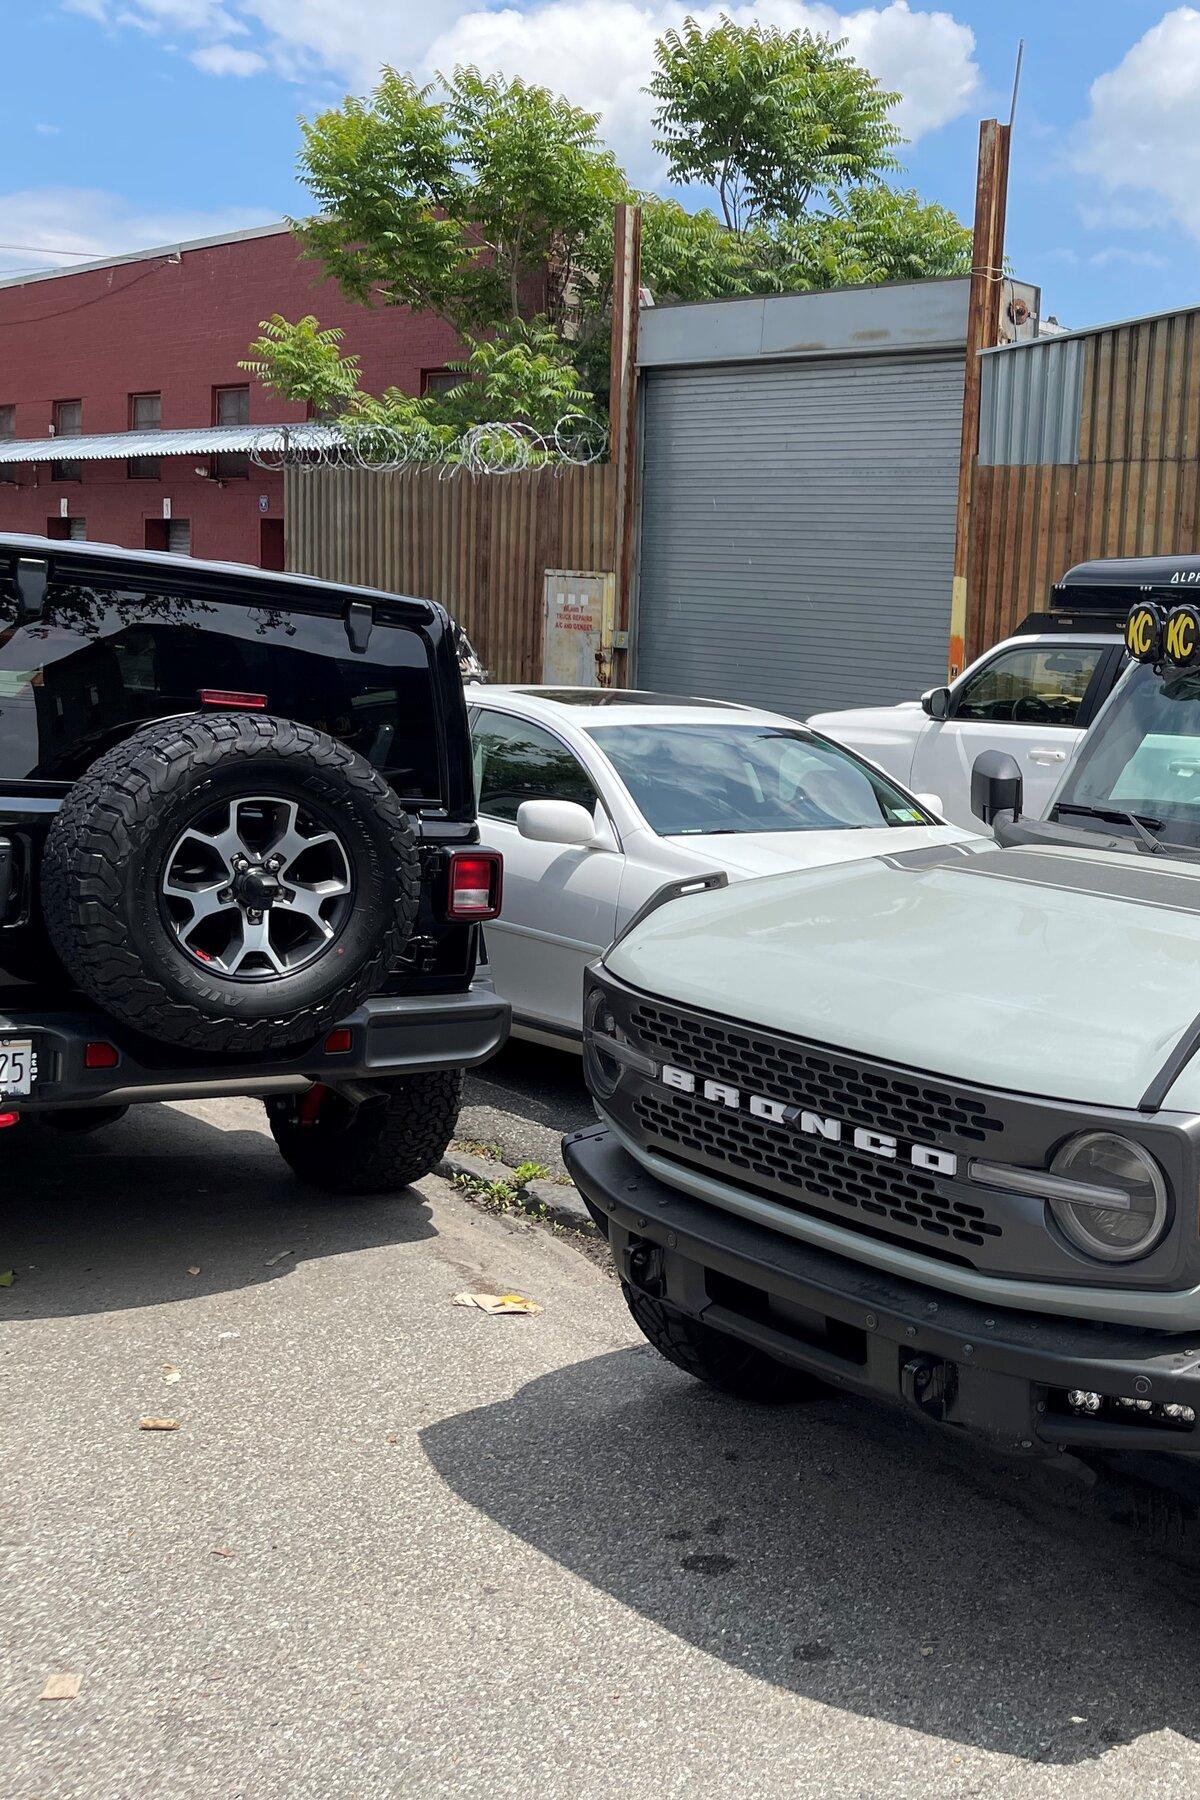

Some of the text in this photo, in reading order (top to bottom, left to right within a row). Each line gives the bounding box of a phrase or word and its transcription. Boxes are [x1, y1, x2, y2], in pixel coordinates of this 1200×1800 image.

[556, 613, 593, 622] TRUCK REPAIRS
[1127, 610, 1153, 655] KC
[1166, 613, 1195, 659] KC
[662, 1064, 958, 1176] BRONCO
